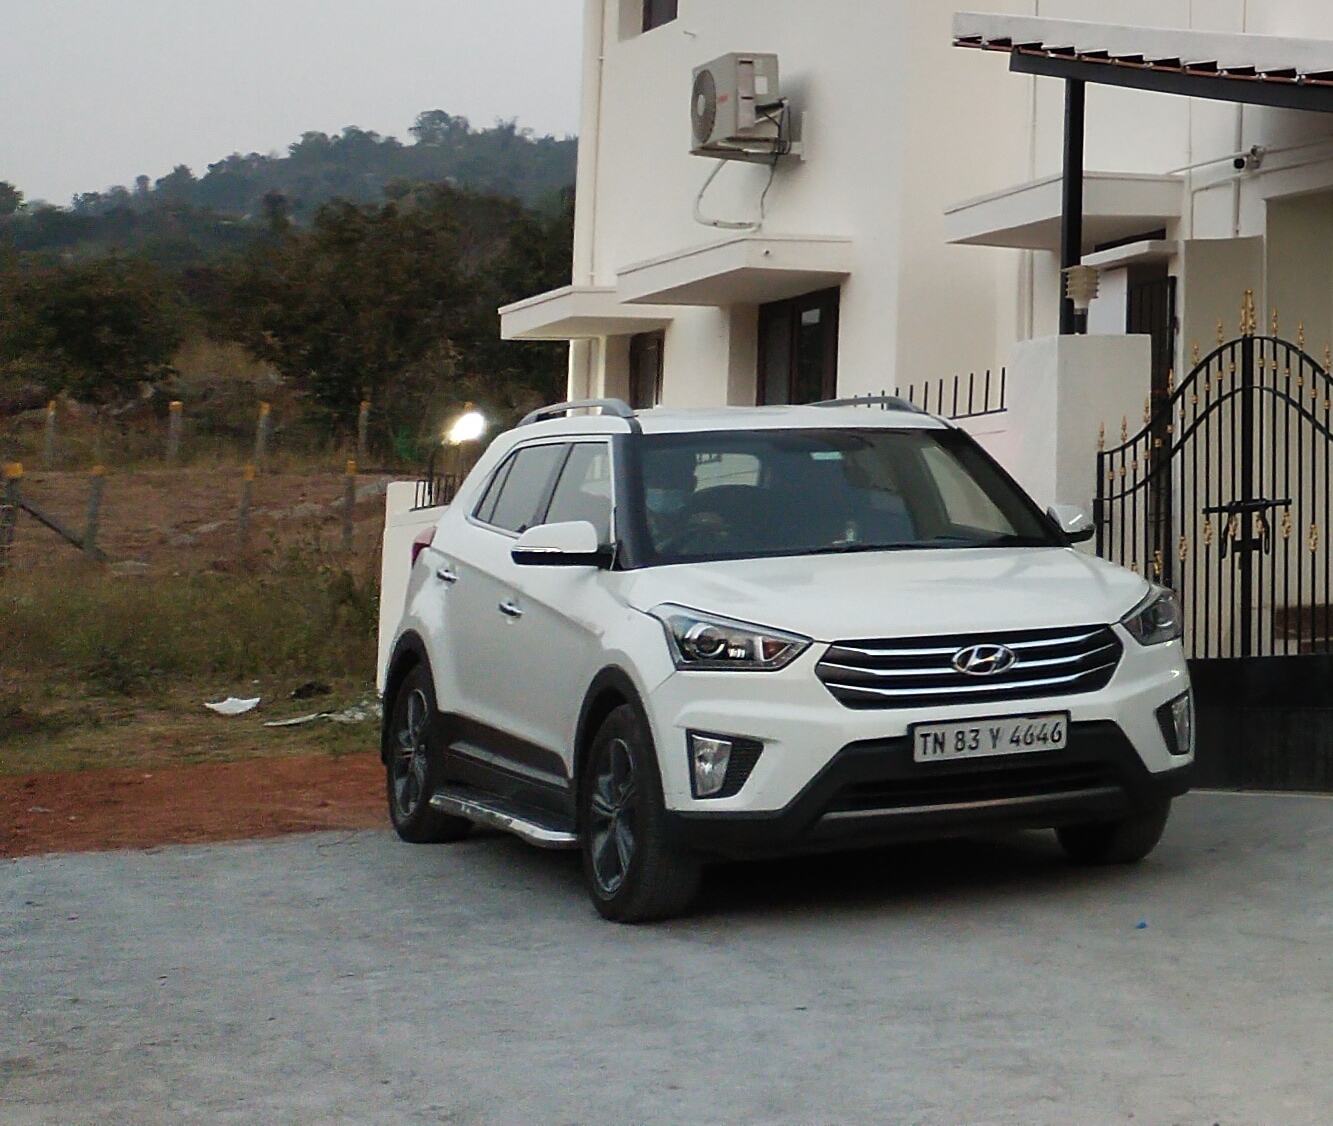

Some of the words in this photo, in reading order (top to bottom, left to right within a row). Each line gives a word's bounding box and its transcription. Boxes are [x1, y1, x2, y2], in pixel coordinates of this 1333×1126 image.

[919, 730, 946, 755] TN
[954, 728, 980, 752] 83
[989, 727, 1001, 749] Y
[1009, 721, 1063, 746] 4646
